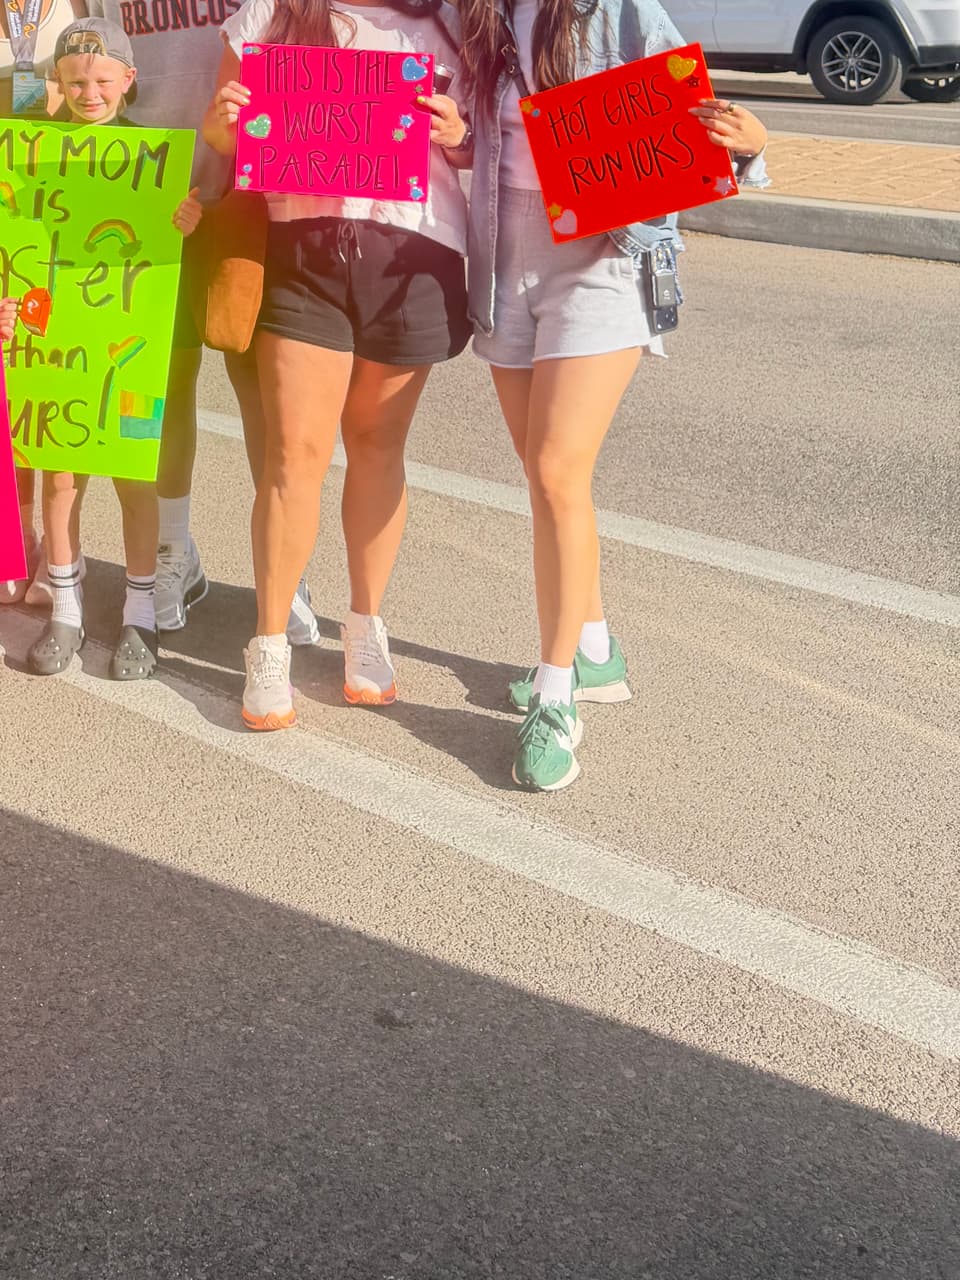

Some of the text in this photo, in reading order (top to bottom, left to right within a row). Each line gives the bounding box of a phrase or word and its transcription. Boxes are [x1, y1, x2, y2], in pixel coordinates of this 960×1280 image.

[259, 46, 398, 96] THIS IS THE
[283, 100, 383, 144] WORST
[548, 73, 673, 149] HOT GIRLS
[59, 135, 170, 191] MOM
[568, 150, 623, 196] RUN
[33, 180, 70, 223] is
[3, 334, 87, 373] than
